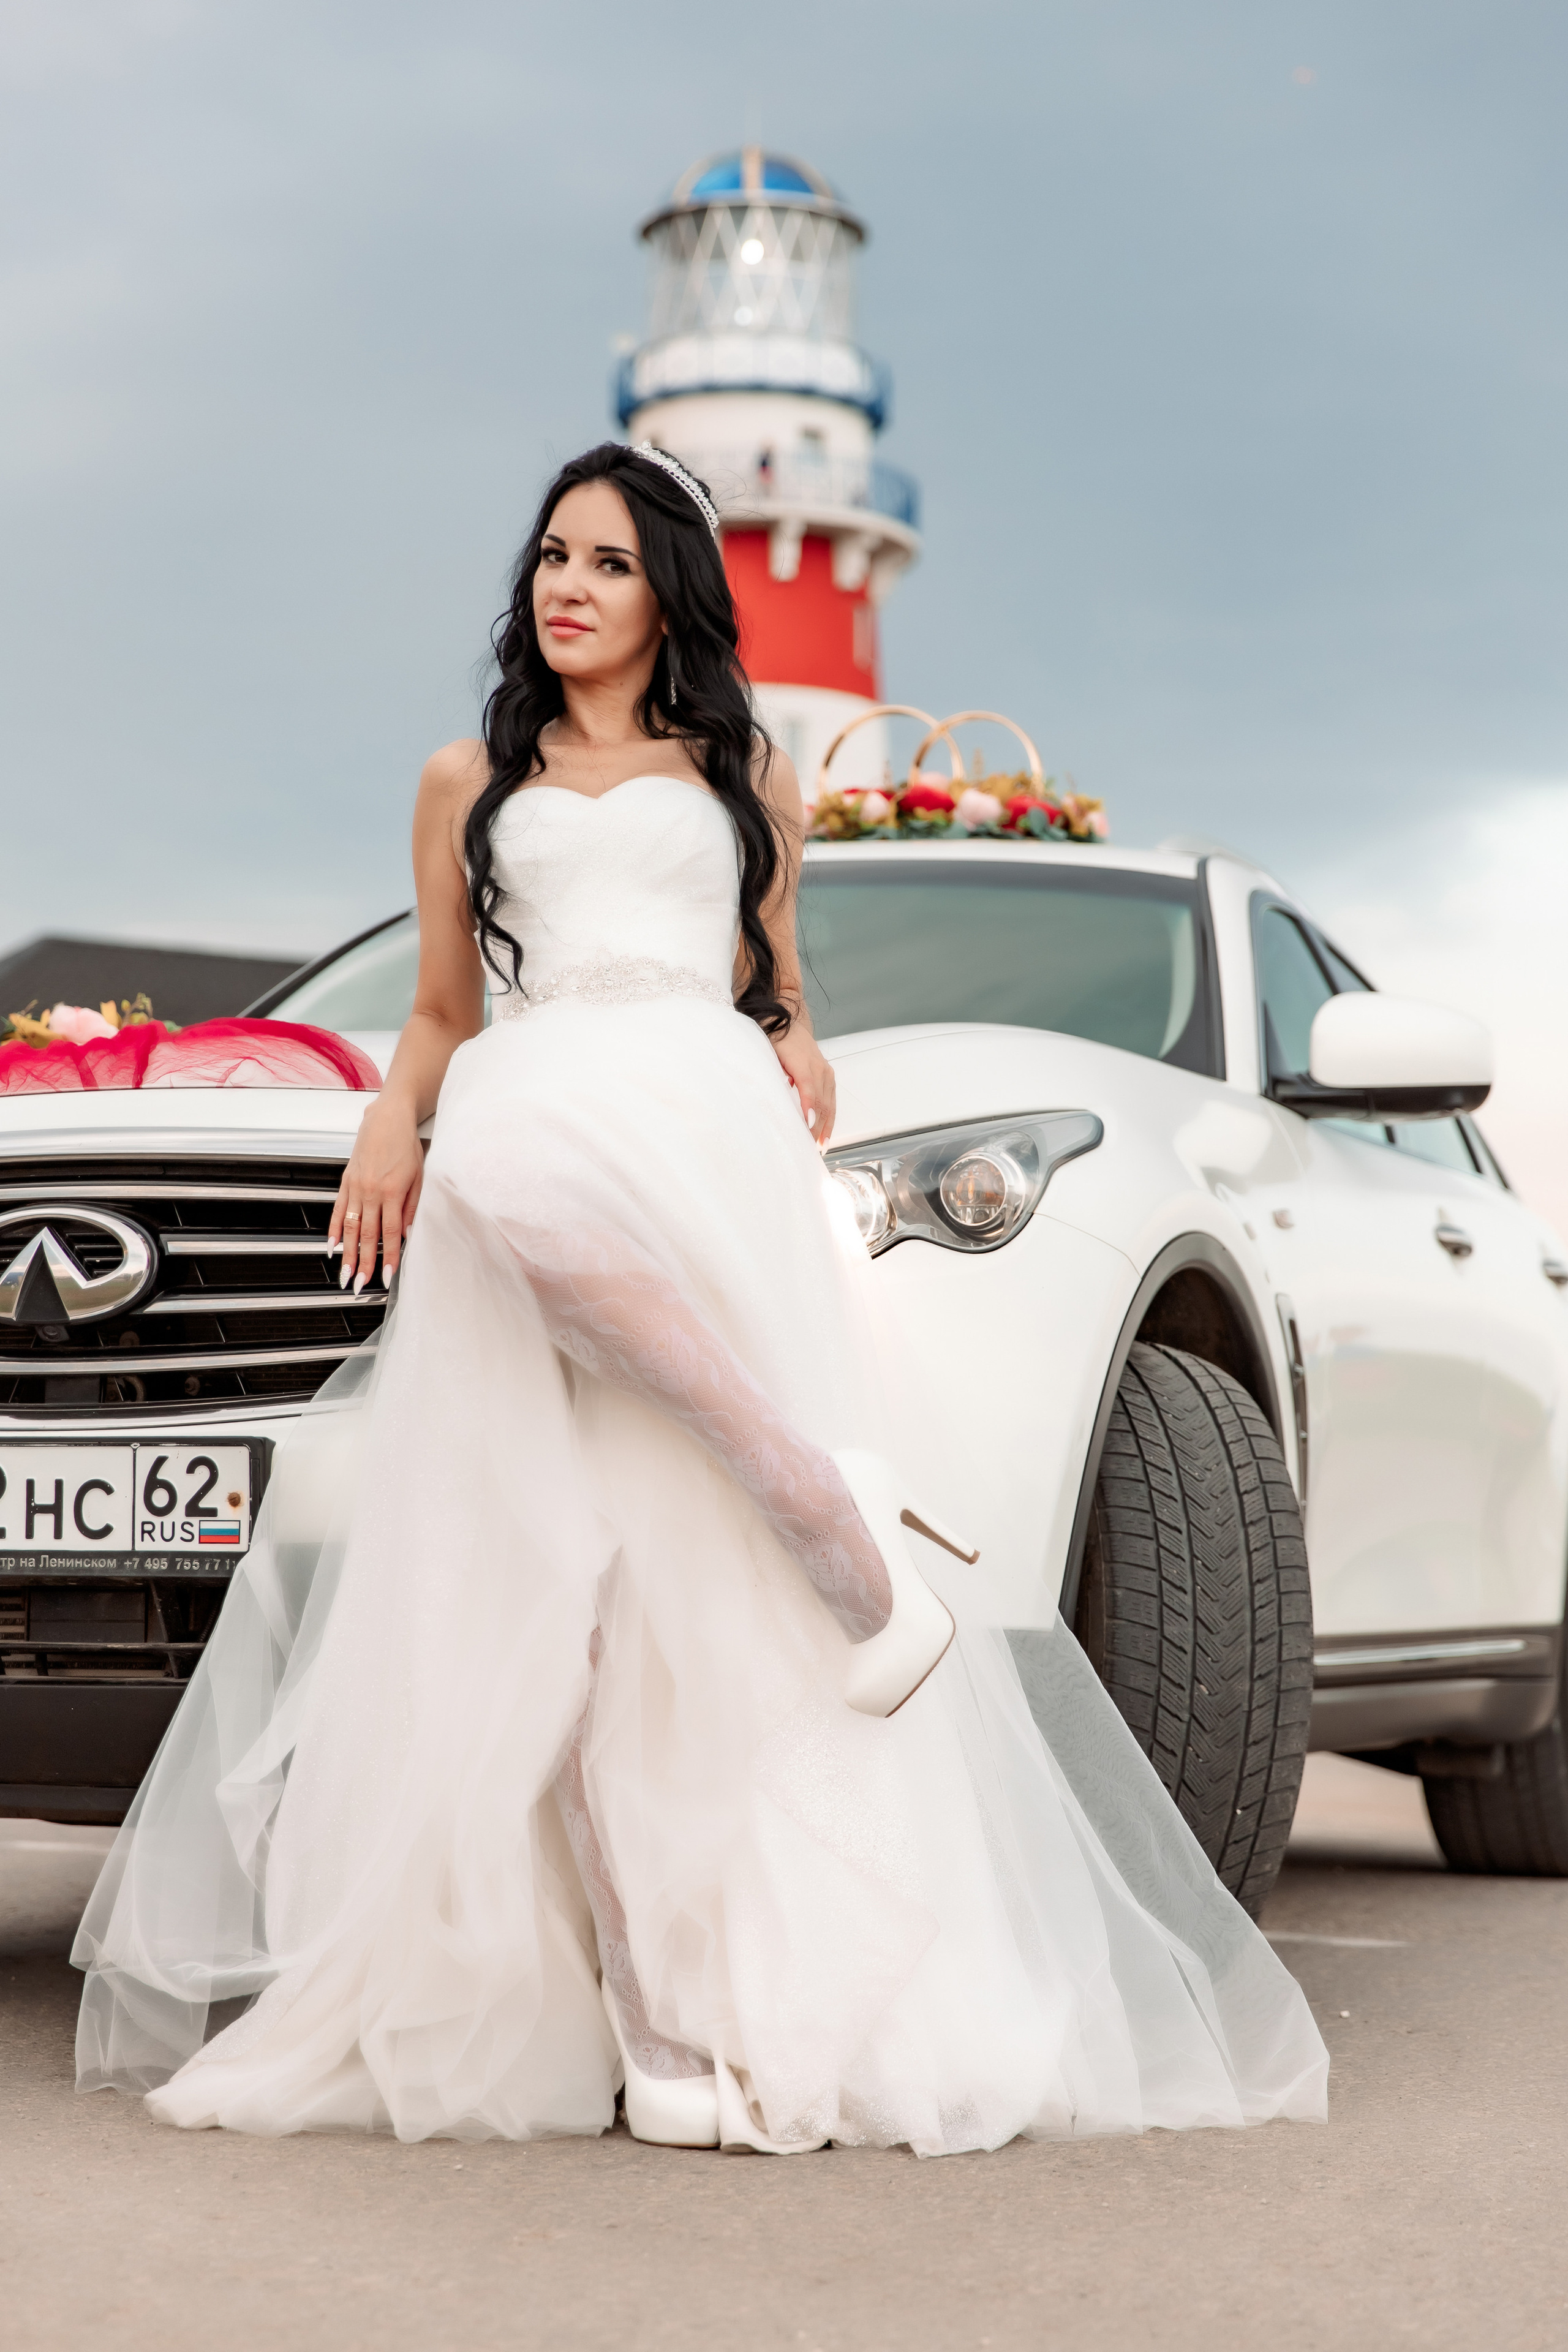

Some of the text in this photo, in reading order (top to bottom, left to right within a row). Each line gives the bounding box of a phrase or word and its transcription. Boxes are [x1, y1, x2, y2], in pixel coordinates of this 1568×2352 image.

[0, 1455, 219, 1540] HC 62
[140, 1521, 195, 1542] RUS
[20, 1557, 36, 1568] на
[39, 1555, 116, 1569] Ленинском
[124, 1558, 140, 1570] +7
[144, 1557, 168, 1570] 495
[175, 1558, 200, 1570] 755
[205, 1558, 221, 1571] 77
